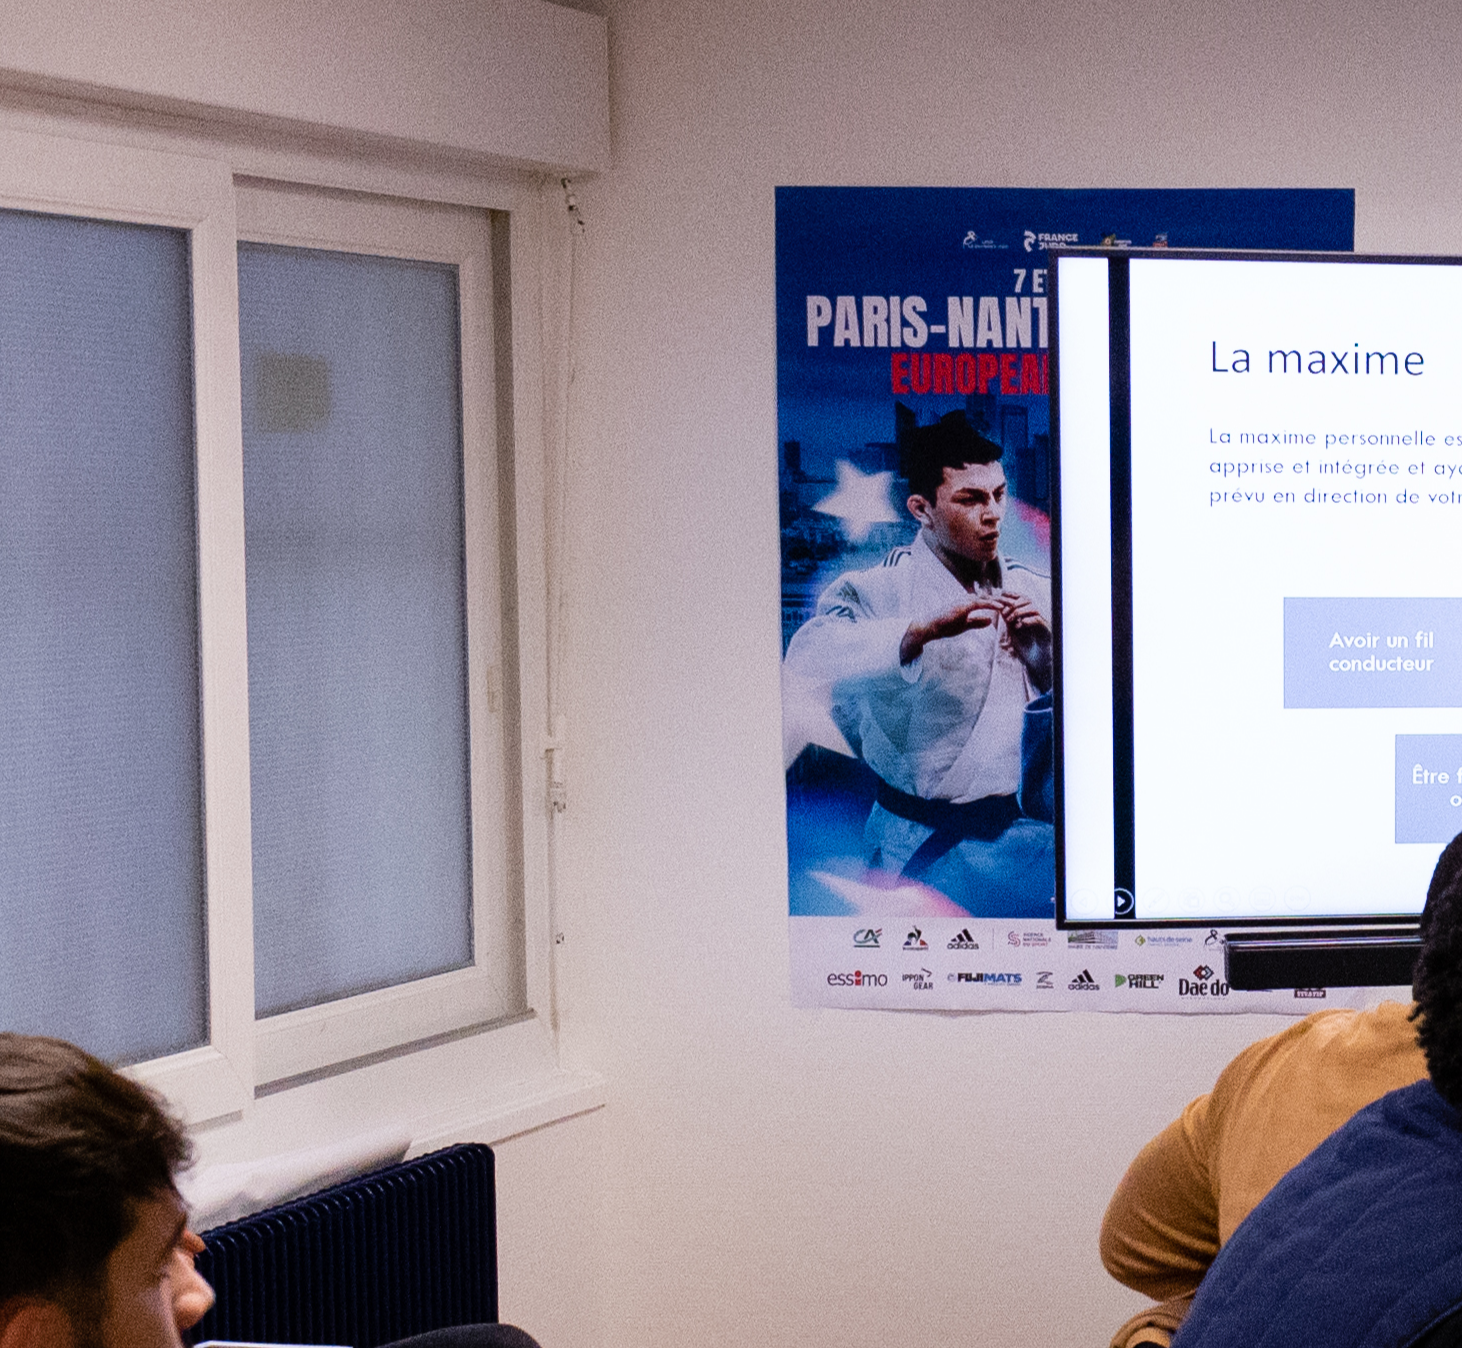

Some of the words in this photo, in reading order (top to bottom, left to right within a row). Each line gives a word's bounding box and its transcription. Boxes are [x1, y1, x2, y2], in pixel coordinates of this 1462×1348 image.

[1038, 233, 1078, 242] FRANCE
[1013, 268, 1026, 293] 7
[1211, 341, 1251, 374] La
[1268, 342, 1426, 376] maxime
[1210, 428, 1231, 446] La
[1240, 431, 1317, 447] maxime
[1325, 430, 1436, 450] personnelle
[1210, 459, 1285, 479] apprise
[1292, 460, 1310, 475] et
[1319, 459, 1400, 480] intégrée
[1408, 461, 1426, 476] et
[1210, 488, 1265, 508] prévu
[1274, 490, 1295, 504] en
[1304, 488, 1387, 505] direction
[1396, 489, 1420, 506] de
[1329, 631, 1380, 649] Avoir
[1387, 635, 1408, 649] un
[1415, 631, 1434, 649] fil
[1329, 656, 1434, 672] conducteur
[1412, 763, 1449, 785] Être
[947, 941, 980, 951] adidas
[827, 970, 888, 987] essimo
[902, 974, 924, 982] IPPON
[913, 981, 933, 990] GEAR
[957, 973, 1022, 984] FUJIMATS
[1128, 980, 1159, 989] HILL
[1067, 983, 1100, 991] adidas
[1178, 978, 1209, 996] Dae
[1210, 978, 1230, 996] do
